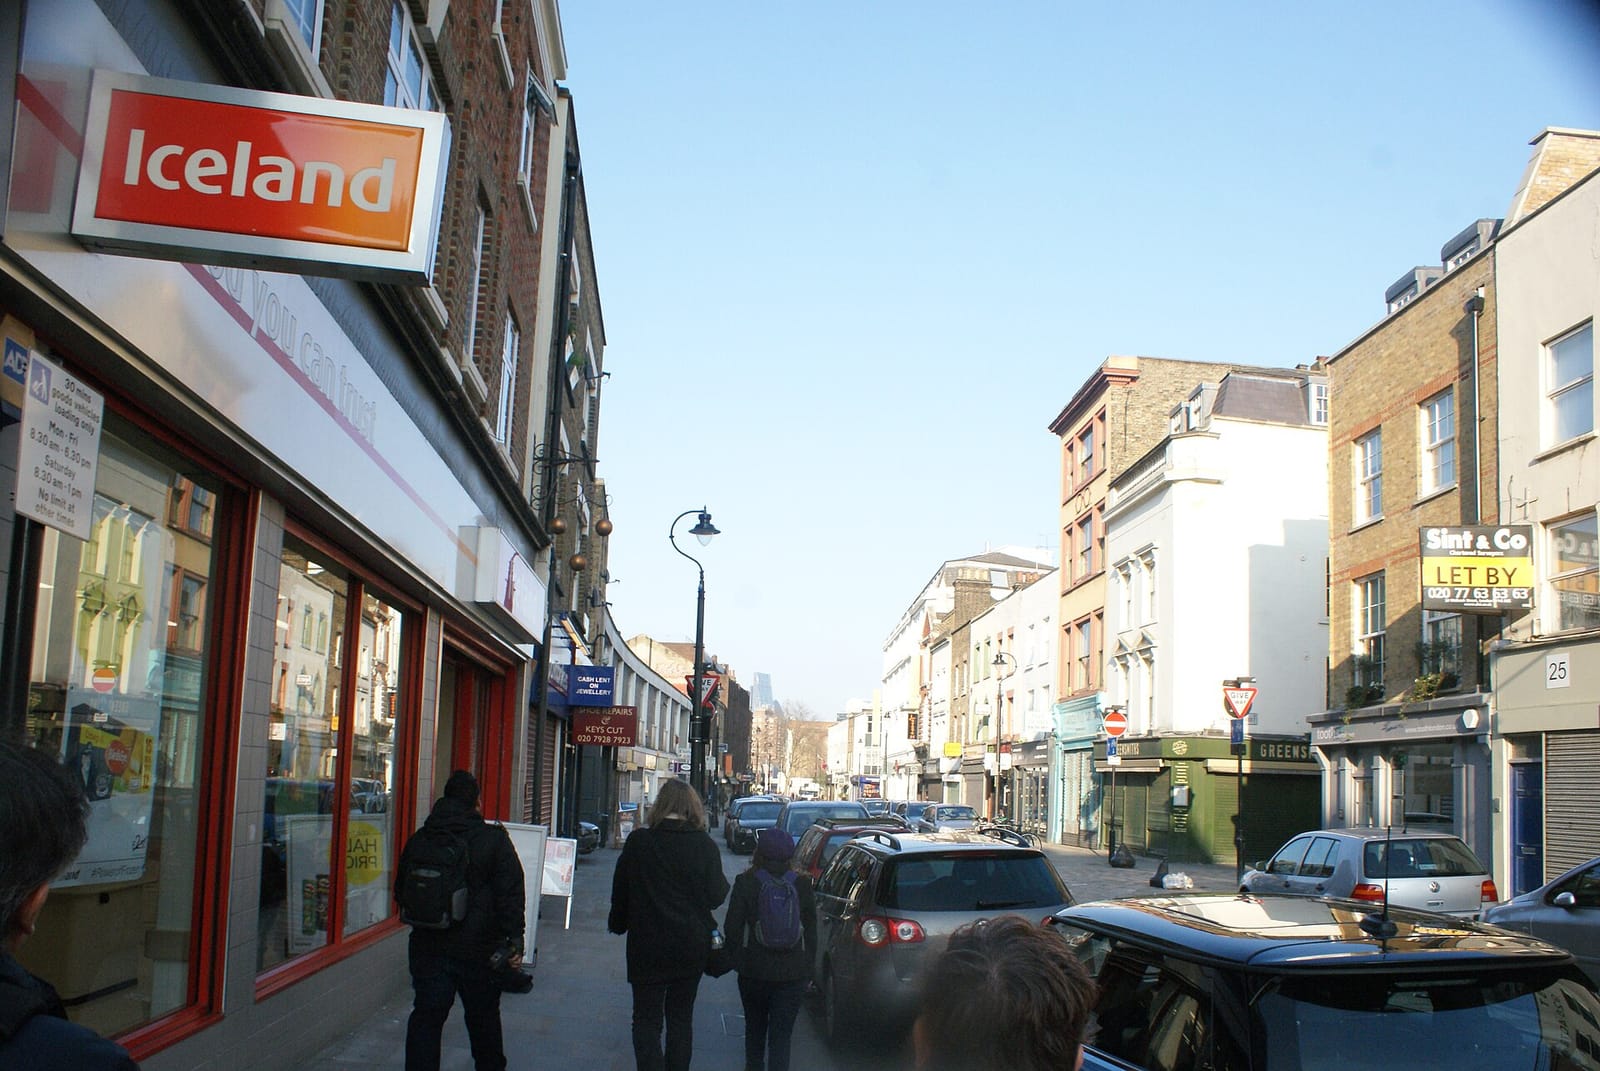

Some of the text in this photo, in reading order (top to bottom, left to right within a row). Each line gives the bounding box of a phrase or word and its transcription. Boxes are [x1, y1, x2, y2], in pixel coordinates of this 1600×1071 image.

[124, 128, 397, 212] Iceland
[3, 349, 28, 375] AD
[249, 270, 377, 448] you can trust
[64, 378, 92, 404] 30 mins
[52, 388, 100, 424] goods vehicles
[54, 402, 94, 436] loading only
[30, 427, 48, 446] 8.30
[64, 446, 80, 464] 6.30
[48, 420, 64, 438] Mon
[69, 432, 78, 446] Fri
[34, 466, 52, 484] 8.30
[44, 454, 76, 480] Saturday
[38, 487, 76, 514] No limit at
[34, 503, 74, 528] other times
[1426, 528, 1528, 550] Sint & Co
[1437, 566, 1518, 586] LET BY
[1428, 587, 1528, 599] 020 77 63 63 63
[1549, 662, 1567, 680] 25
[602, 707, 633, 716] REPAIRS
[577, 735, 631, 744] 020 7928 7923
[585, 726, 604, 734] KEYS
